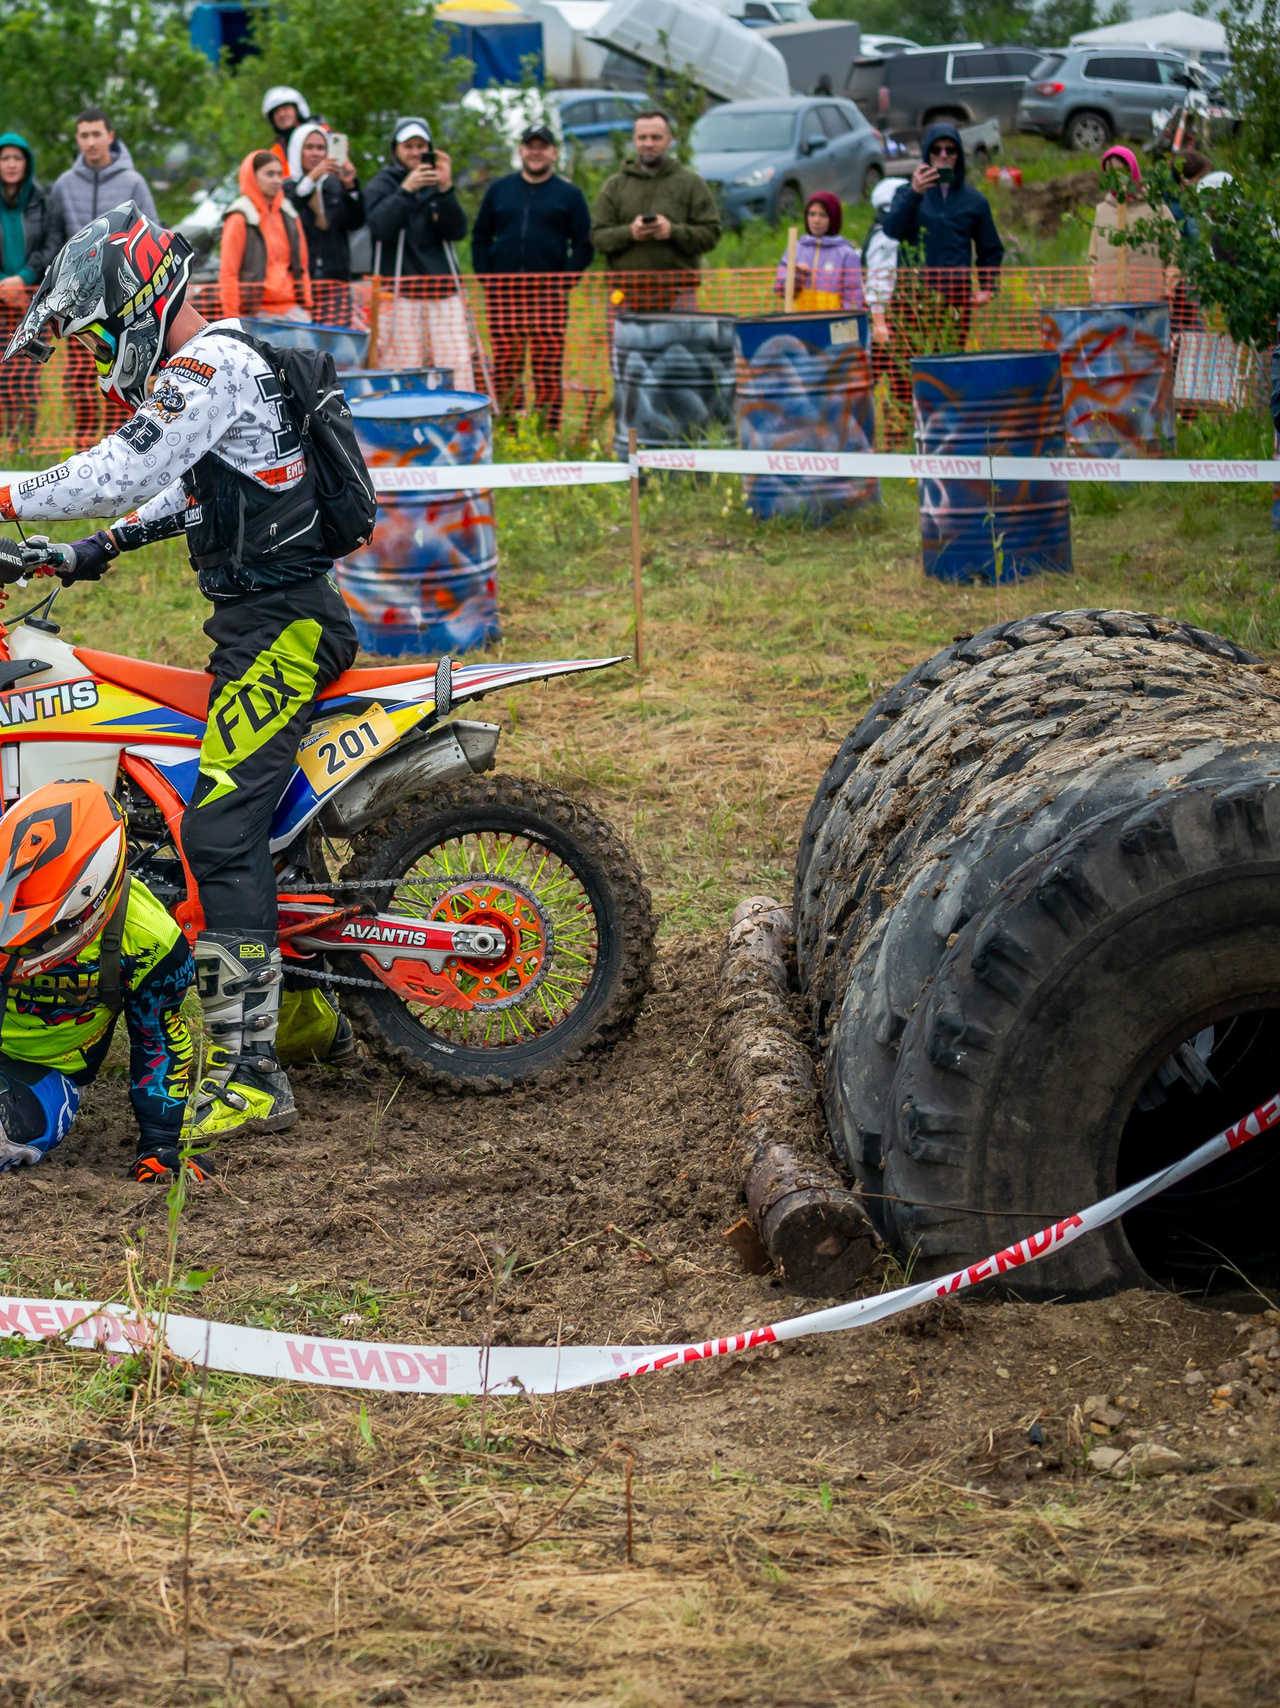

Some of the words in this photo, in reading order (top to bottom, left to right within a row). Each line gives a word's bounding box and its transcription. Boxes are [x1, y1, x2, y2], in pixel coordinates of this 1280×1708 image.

[18, 466, 71, 495] ГУРОВ
[317, 721, 382, 777] 201
[340, 922, 429, 947] AVANTIS
